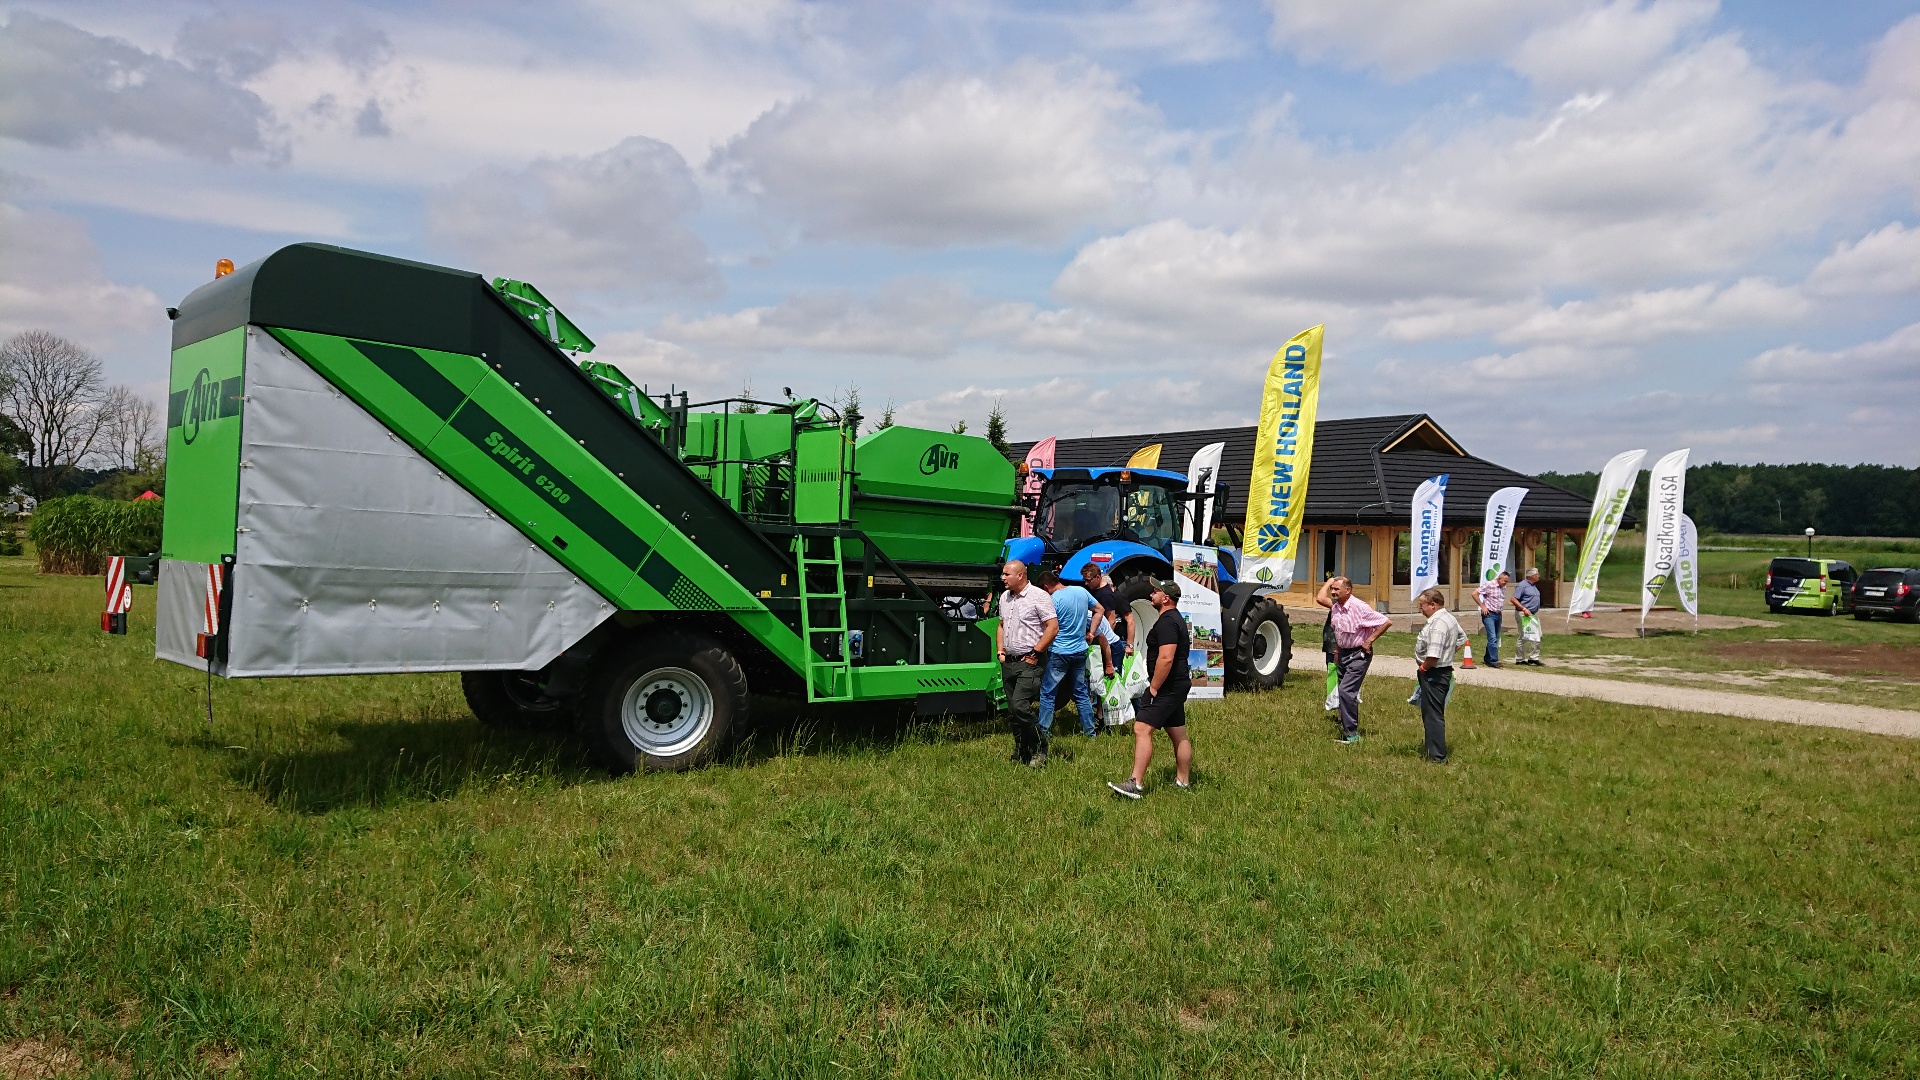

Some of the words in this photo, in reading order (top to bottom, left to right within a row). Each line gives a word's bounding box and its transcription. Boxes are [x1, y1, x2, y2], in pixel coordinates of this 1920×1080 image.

[183, 368, 219, 445] AVR
[1275, 344, 1307, 456] HOLLAND
[484, 431, 535, 475] Spirit
[535, 474, 571, 504] 6200
[919, 443, 960, 475] AVR
[1269, 462, 1294, 517] NEW
[1416, 509, 1432, 577] Ranman
[1489, 504, 1508, 561] BELCHIM
[1580, 531, 1613, 590] Zielone
[1603, 488, 1629, 526] Pola
